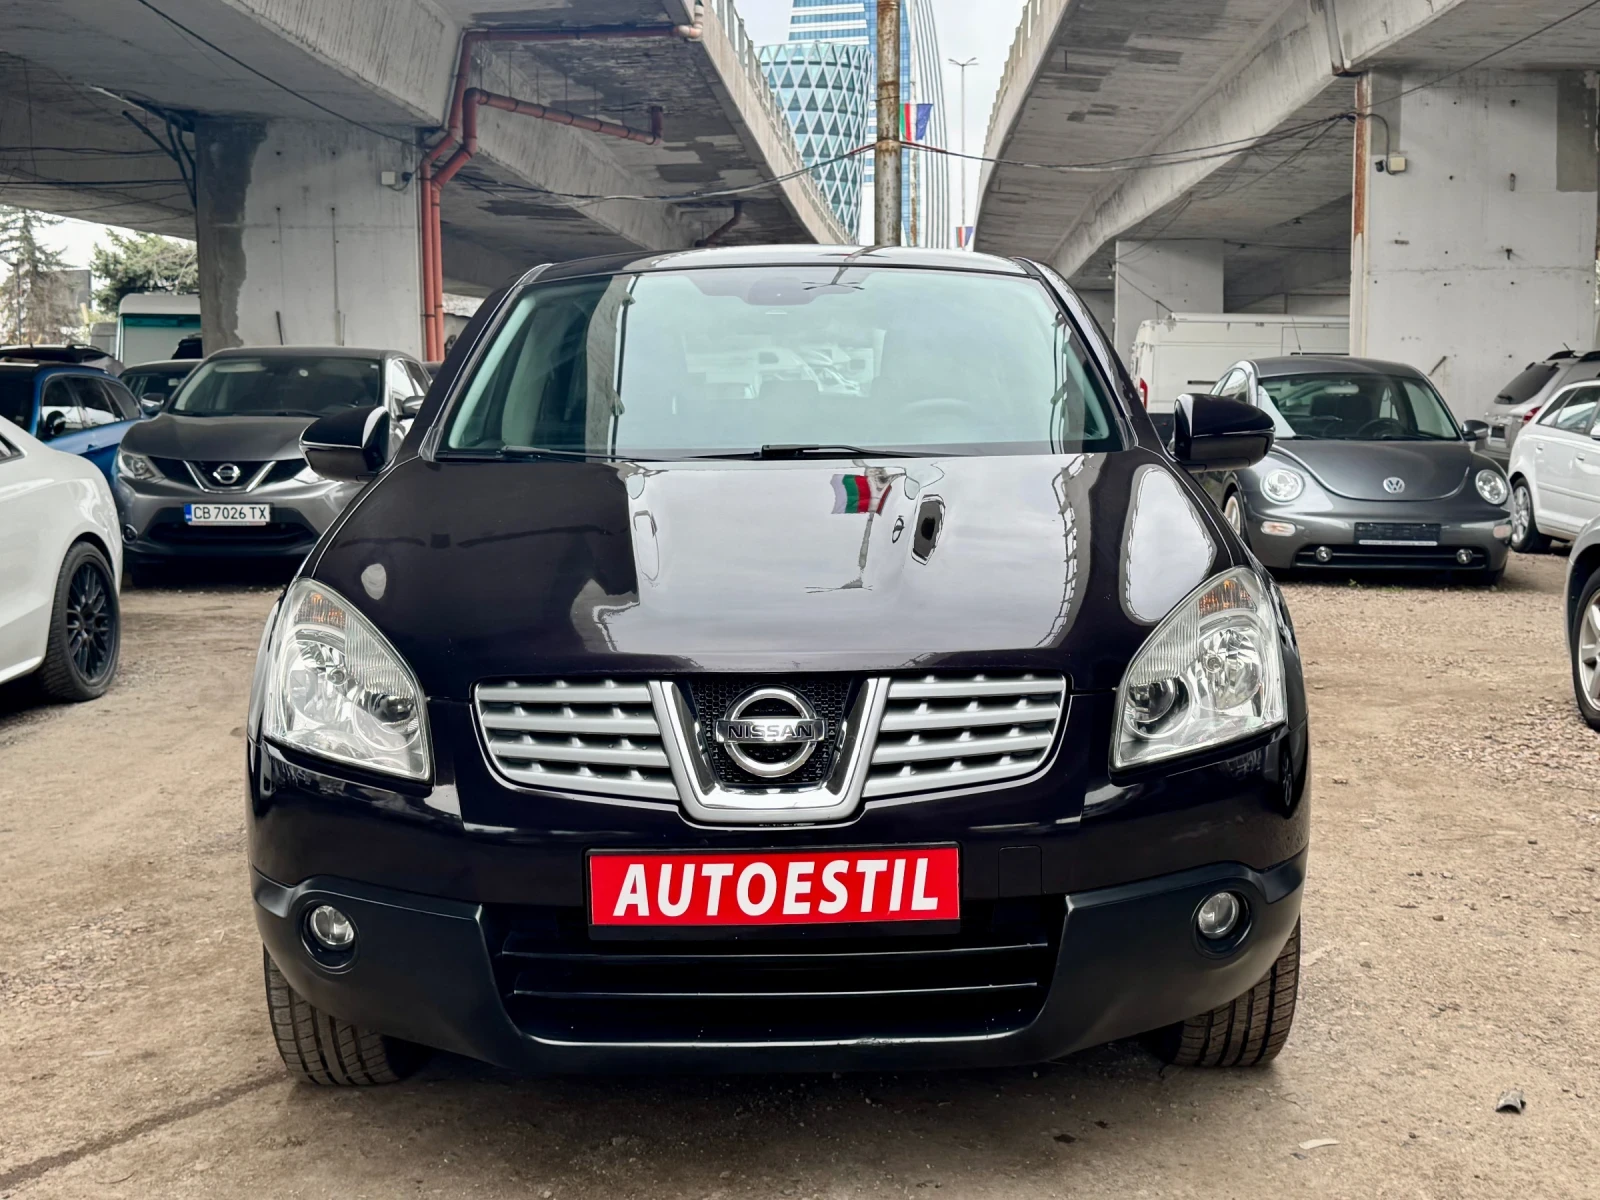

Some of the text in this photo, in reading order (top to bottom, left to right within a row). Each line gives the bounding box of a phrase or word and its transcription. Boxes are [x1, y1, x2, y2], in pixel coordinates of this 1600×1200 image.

[193, 506, 267, 520] CB 7026 TX
[727, 724, 815, 739] NISSAN
[612, 857, 939, 917] AUTOESTIL
